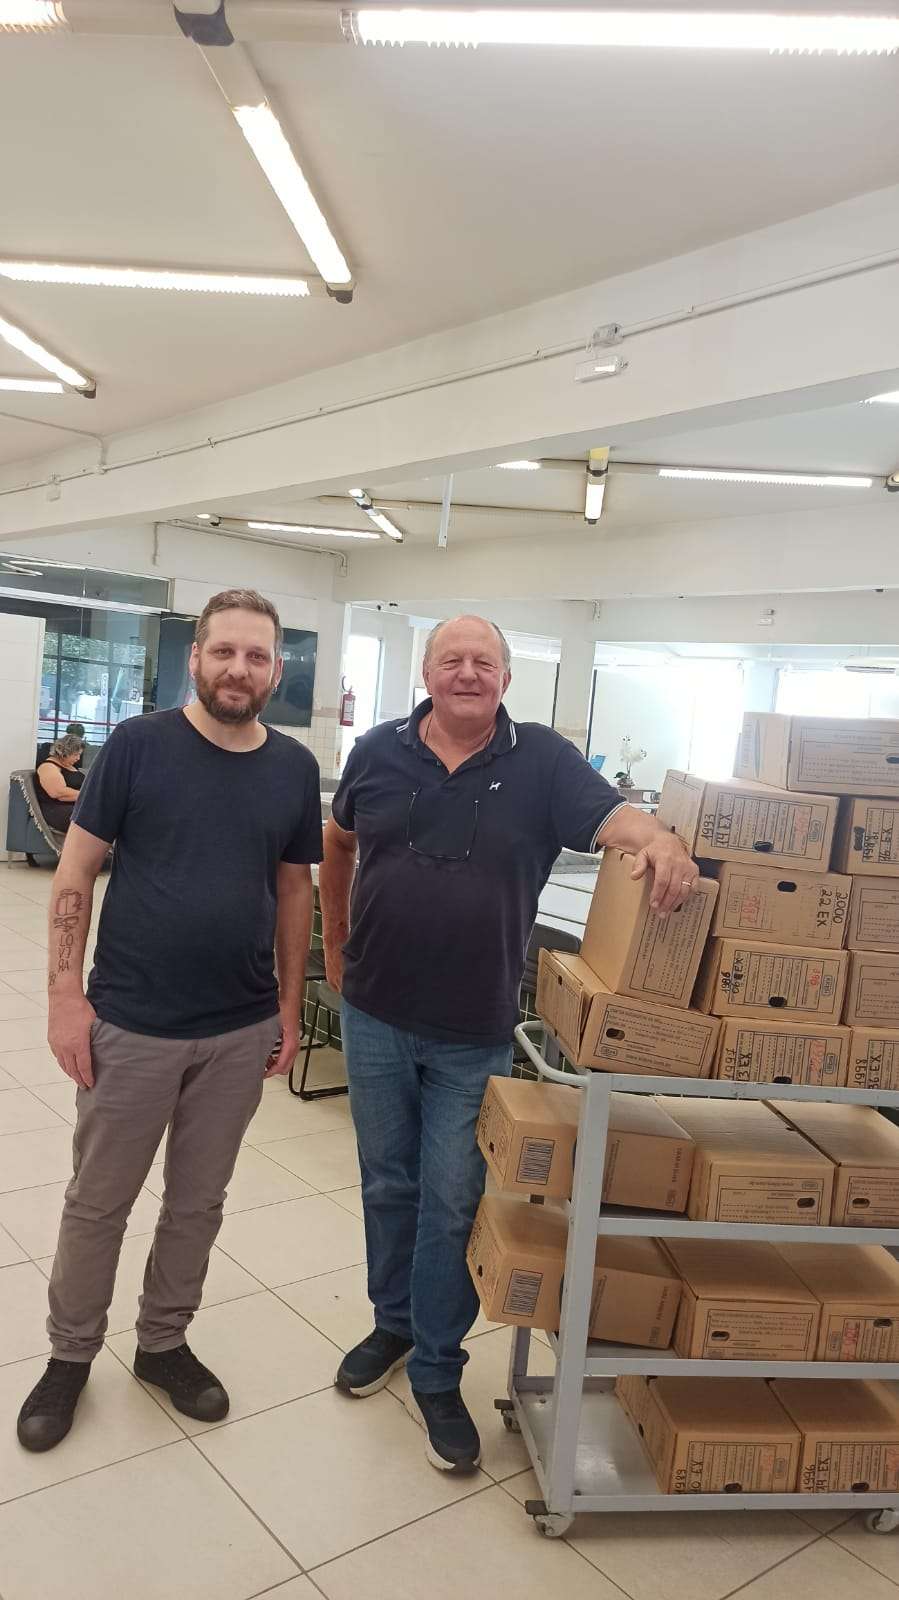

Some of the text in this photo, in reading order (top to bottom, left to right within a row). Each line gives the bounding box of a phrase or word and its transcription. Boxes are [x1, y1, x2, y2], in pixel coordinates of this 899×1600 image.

[701, 814, 715, 840] 1993
[816, 889, 833, 928] 22 EX
[832, 888, 849, 924] 2000
[720, 970, 731, 993] 1986
[738, 1052, 752, 1067] EX
[869, 1054, 881, 1072] EX
